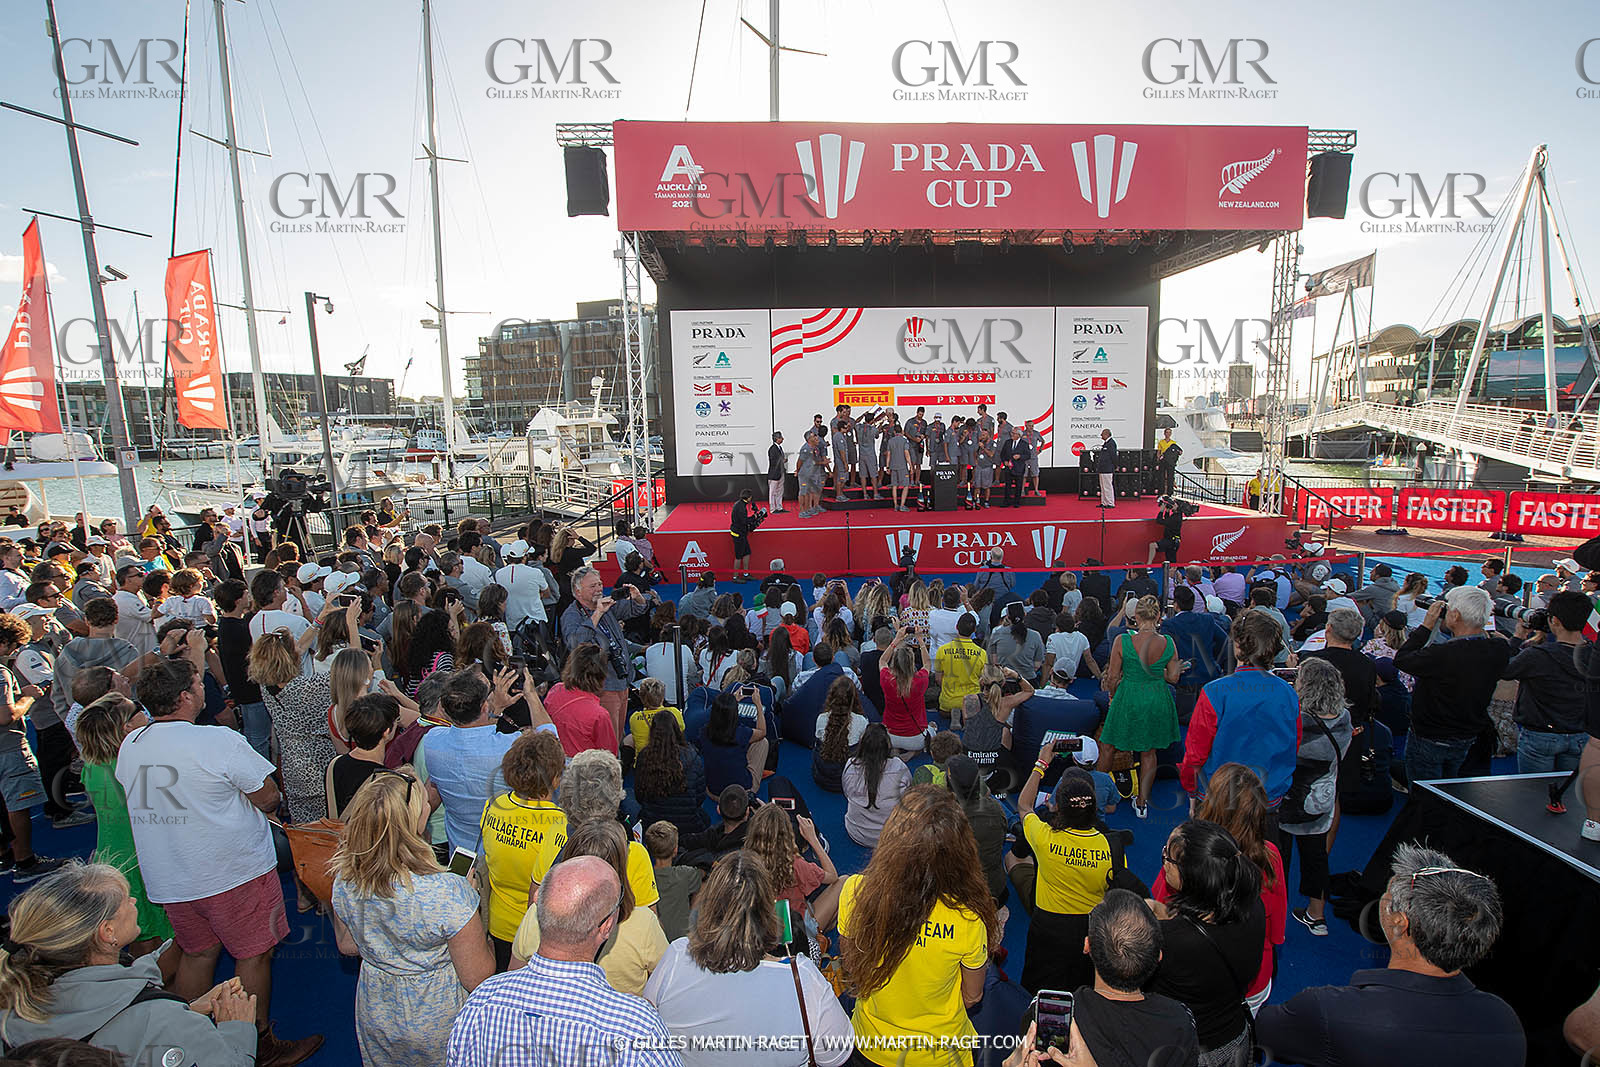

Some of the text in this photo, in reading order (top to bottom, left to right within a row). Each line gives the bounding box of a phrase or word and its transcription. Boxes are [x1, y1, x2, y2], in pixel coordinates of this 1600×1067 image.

[891, 143, 1046, 172] PRADA
[926, 179, 1012, 208] CUP
[692, 327, 746, 339] PRADA
[1074, 324, 1123, 334] PRADA
[904, 374, 940, 382] LUNA
[839, 390, 890, 403] PIRELLI
[1307, 495, 1383, 519] FASTER
[1407, 496, 1493, 524] FASTER
[1518, 501, 1600, 530] FASTE
[936, 531, 1018, 549] PRADA
[967, 750, 999, 758] Emirates
[487, 815, 519, 838] VILLAGE
[1049, 843, 1087, 860] VILLAGE
